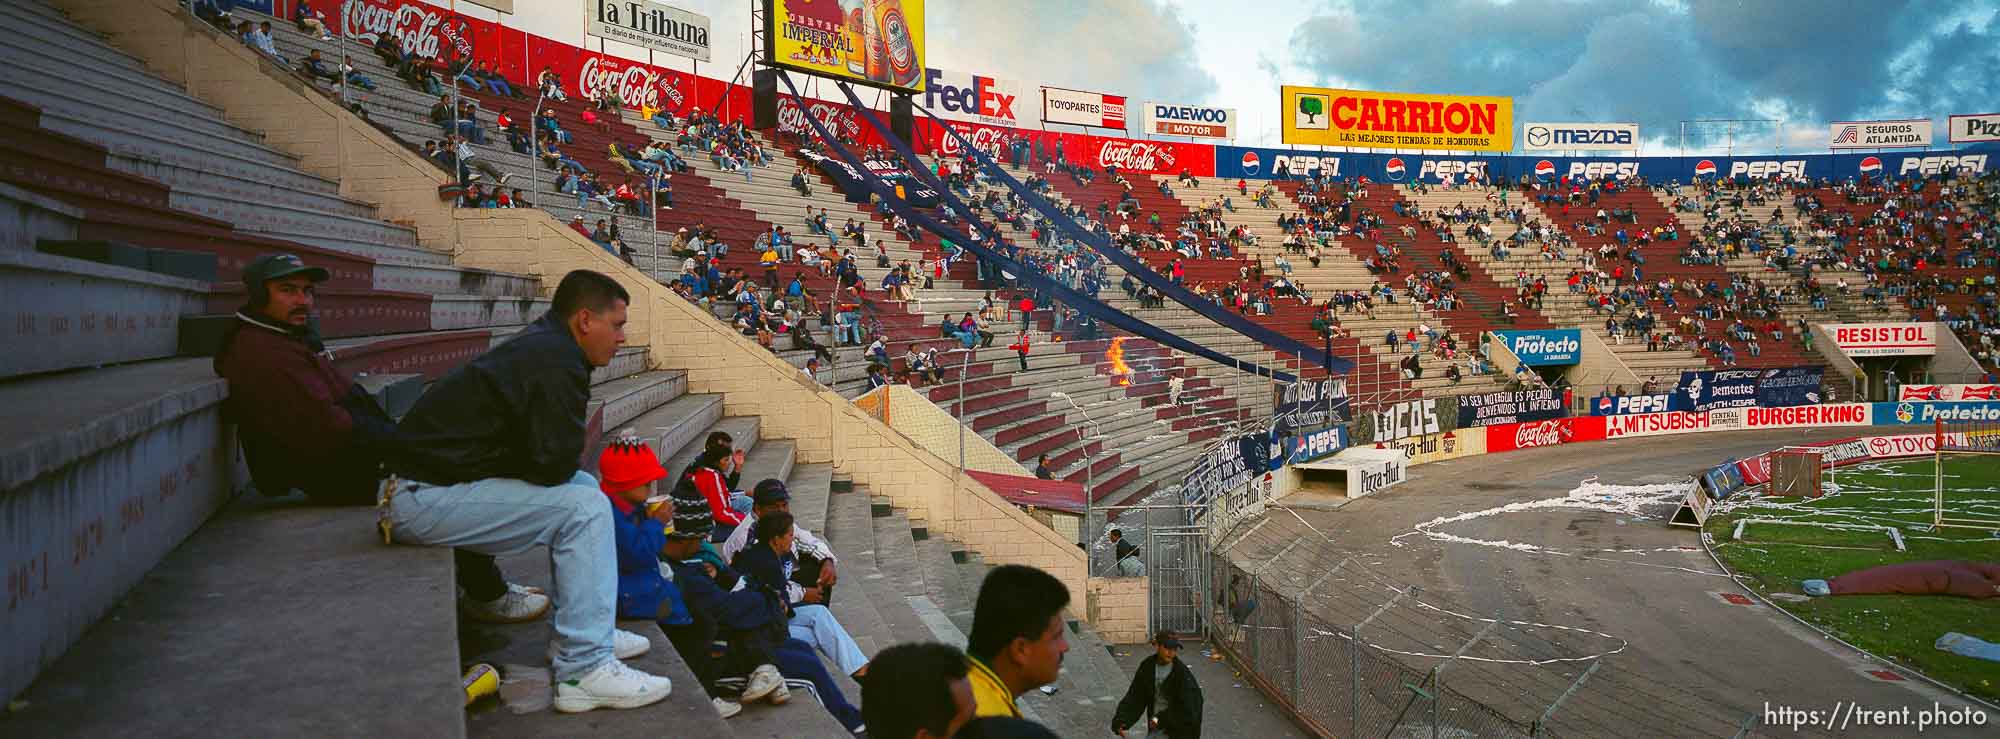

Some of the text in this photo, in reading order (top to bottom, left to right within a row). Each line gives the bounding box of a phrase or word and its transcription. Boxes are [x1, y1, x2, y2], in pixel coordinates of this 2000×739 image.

[625, 2, 708, 46] Tribuna
[783, 22, 854, 53] IMPERIAL
[580, 57, 660, 106] Coca-Cola
[926, 68, 1015, 120] FedEx
[1050, 99, 1100, 114] TOYOPARTES
[1155, 105, 1227, 123] DAEWOO
[1331, 96, 1497, 135] CARRION
[1174, 124, 1211, 135] MOTOR
[1866, 125, 1912, 134] SEGUROS
[1967, 118, 2000, 136] Piz
[1340, 133, 1490, 147] LAS MEJORES TIENDAS DE HONDURAS
[1865, 134, 1922, 143] ATLANTIDA
[1100, 141, 1158, 171] Coca-Cola
[1900, 154, 1988, 175] PEPSI
[1272, 155, 1340, 177] PEPSI
[1419, 160, 1486, 179] PEPSI
[1568, 162, 1640, 181] PEPSI
[1730, 160, 1806, 179] PEPSI
[1514, 335, 1578, 354] Protecto
[1837, 327, 1928, 343] RESISTOL
[1484, 391, 1513, 407] MOTAGUA
[1515, 391, 1524, 402] ES
[1526, 389, 1552, 401] PECADO
[1712, 383, 1755, 397] Dementes
[1476, 399, 1560, 419] BIENVENIDOS AL INFIERNO
[1617, 394, 1669, 414] PEPSI
[1921, 404, 2000, 421] Protecto
[1373, 399, 1440, 443] LOCOS
[1624, 411, 1710, 433] MITSUBISHI
[1747, 405, 1865, 426] BURGER KING
[1309, 427, 1340, 457] PEPSI
[1516, 420, 1560, 448] Coca-Cola
[1892, 436, 1956, 453] TOYOA
[1361, 462, 1399, 493] Pizza-Hut
